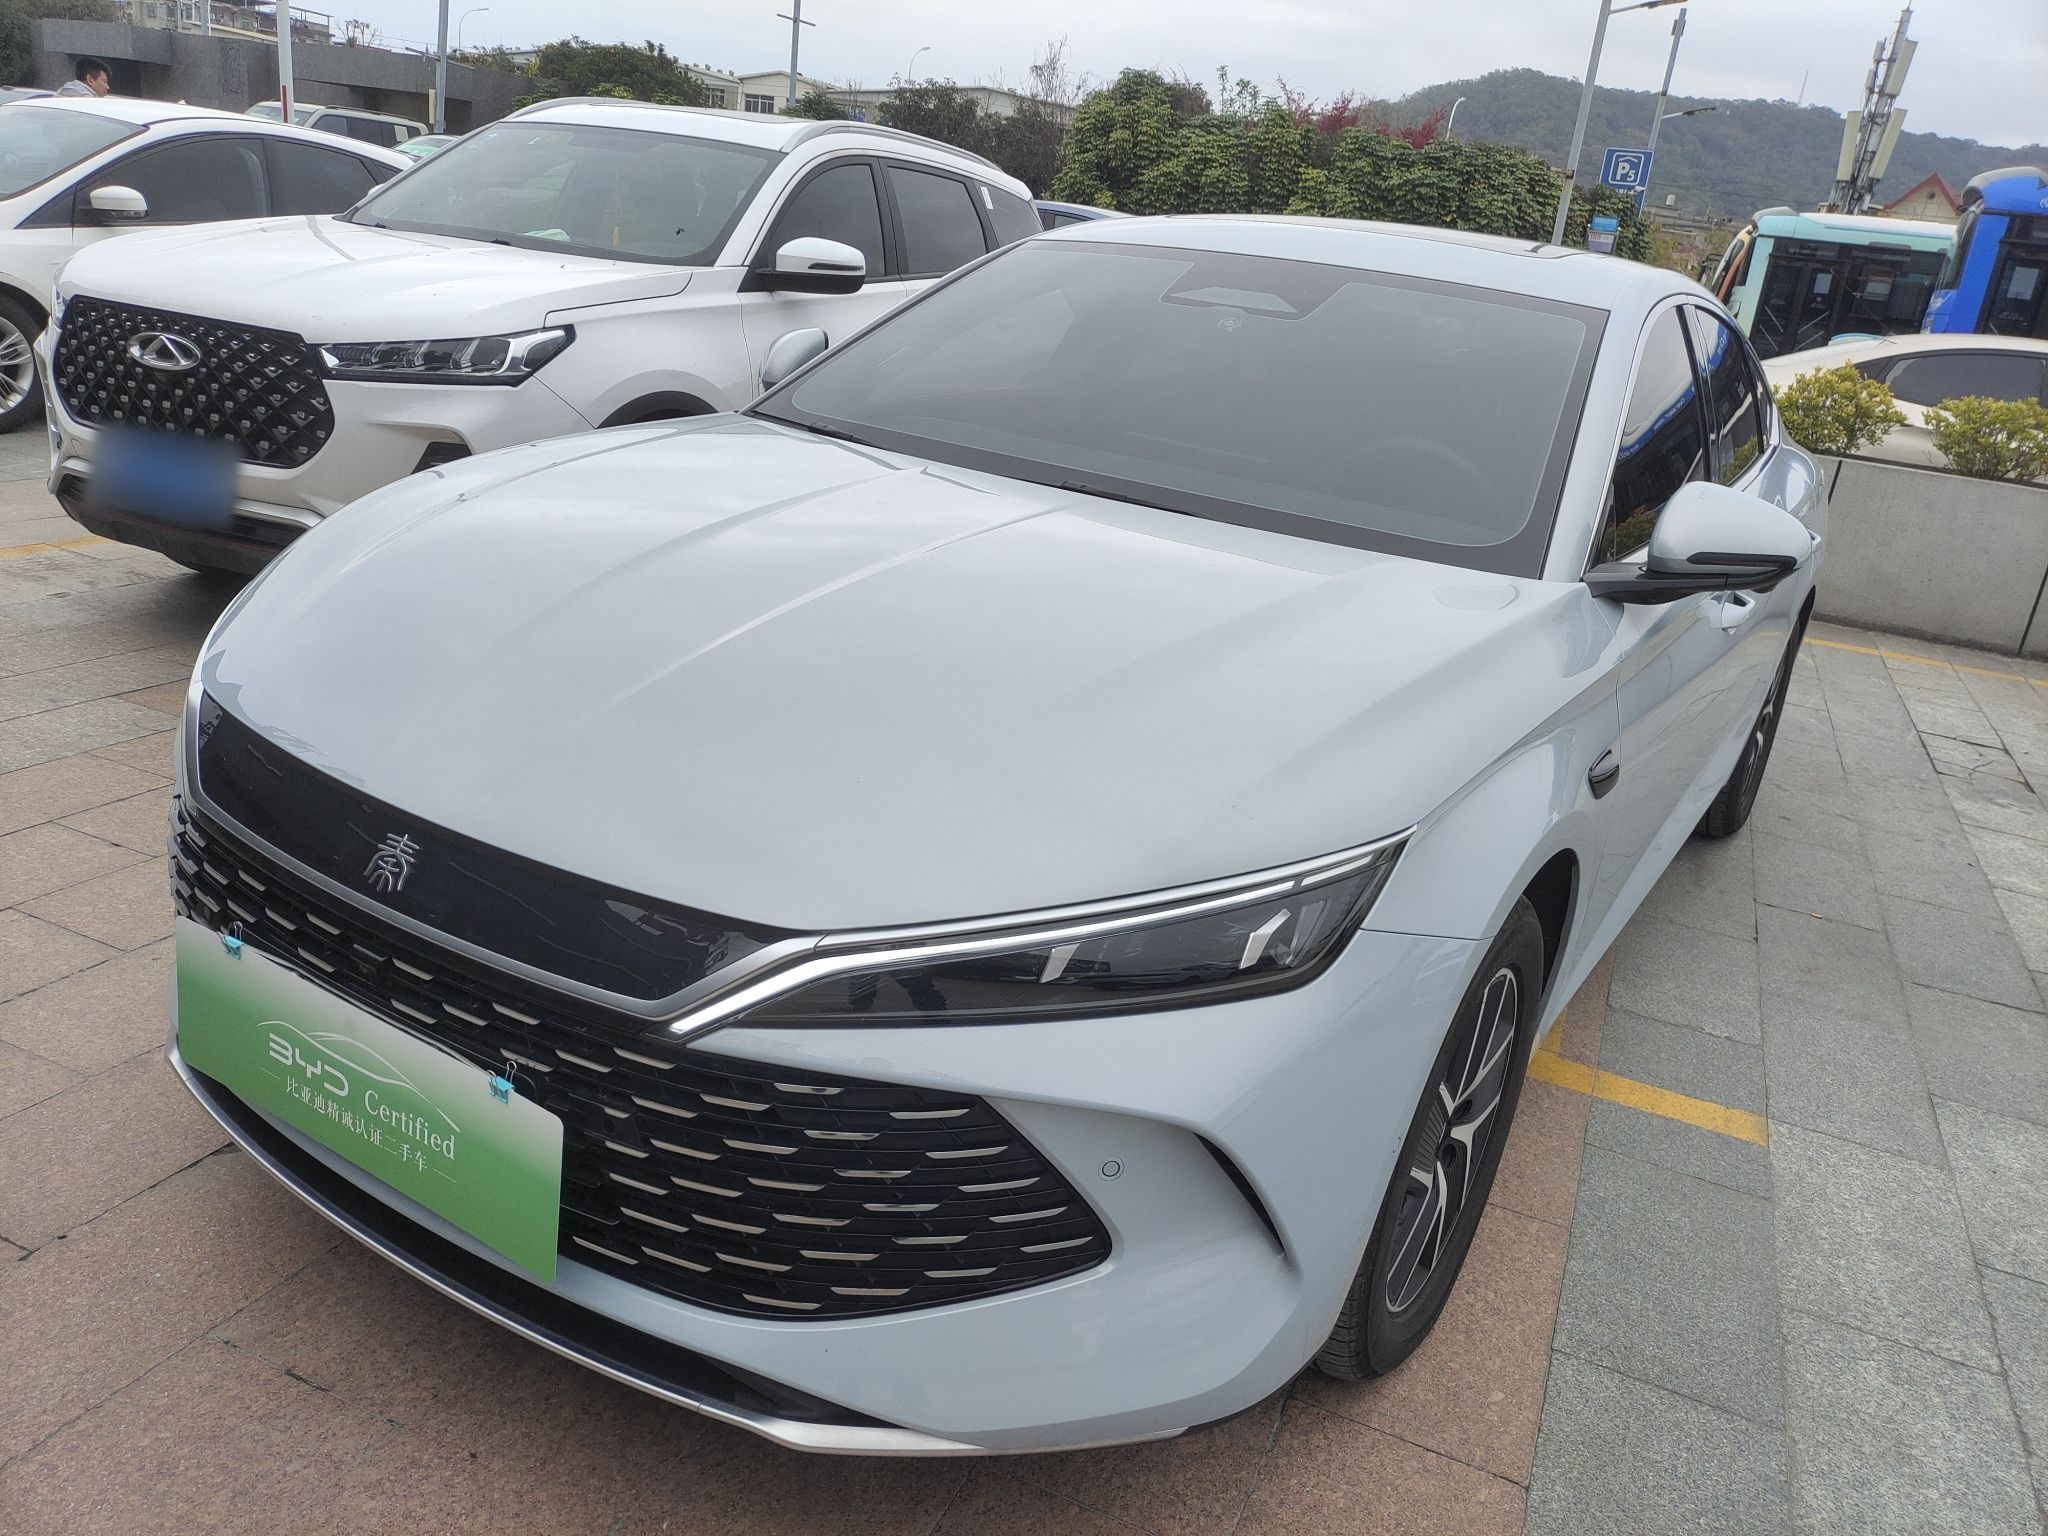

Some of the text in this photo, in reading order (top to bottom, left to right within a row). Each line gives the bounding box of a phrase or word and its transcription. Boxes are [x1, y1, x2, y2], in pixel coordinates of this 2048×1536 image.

[363, 833, 420, 892] 秦
[269, 1032, 456, 1161] BYD Certified
[286, 1075, 428, 1172] 比亚迪精诚认证二手车
